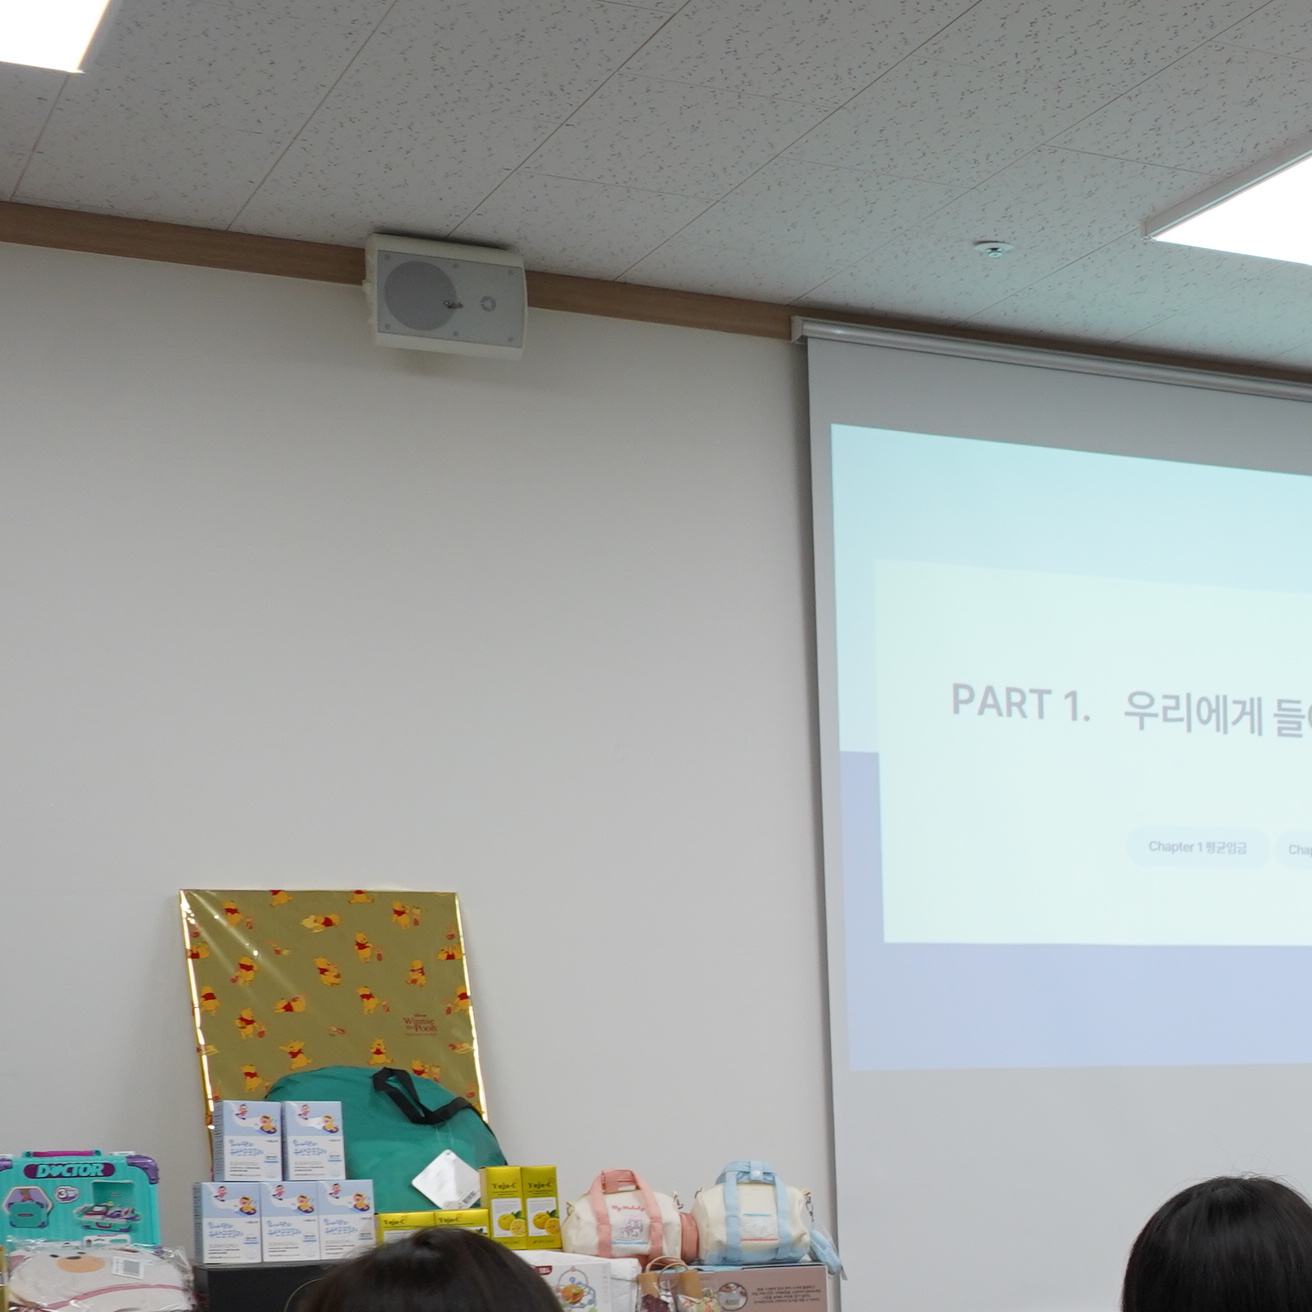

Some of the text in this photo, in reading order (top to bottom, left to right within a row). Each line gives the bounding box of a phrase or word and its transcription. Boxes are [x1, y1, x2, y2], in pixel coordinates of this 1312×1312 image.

[952, 682, 1053, 720] PART
[1063, 690, 1091, 722] 1.
[1123, 690, 1263, 737] 우리에게
[1148, 840, 1195, 855] Chapter
